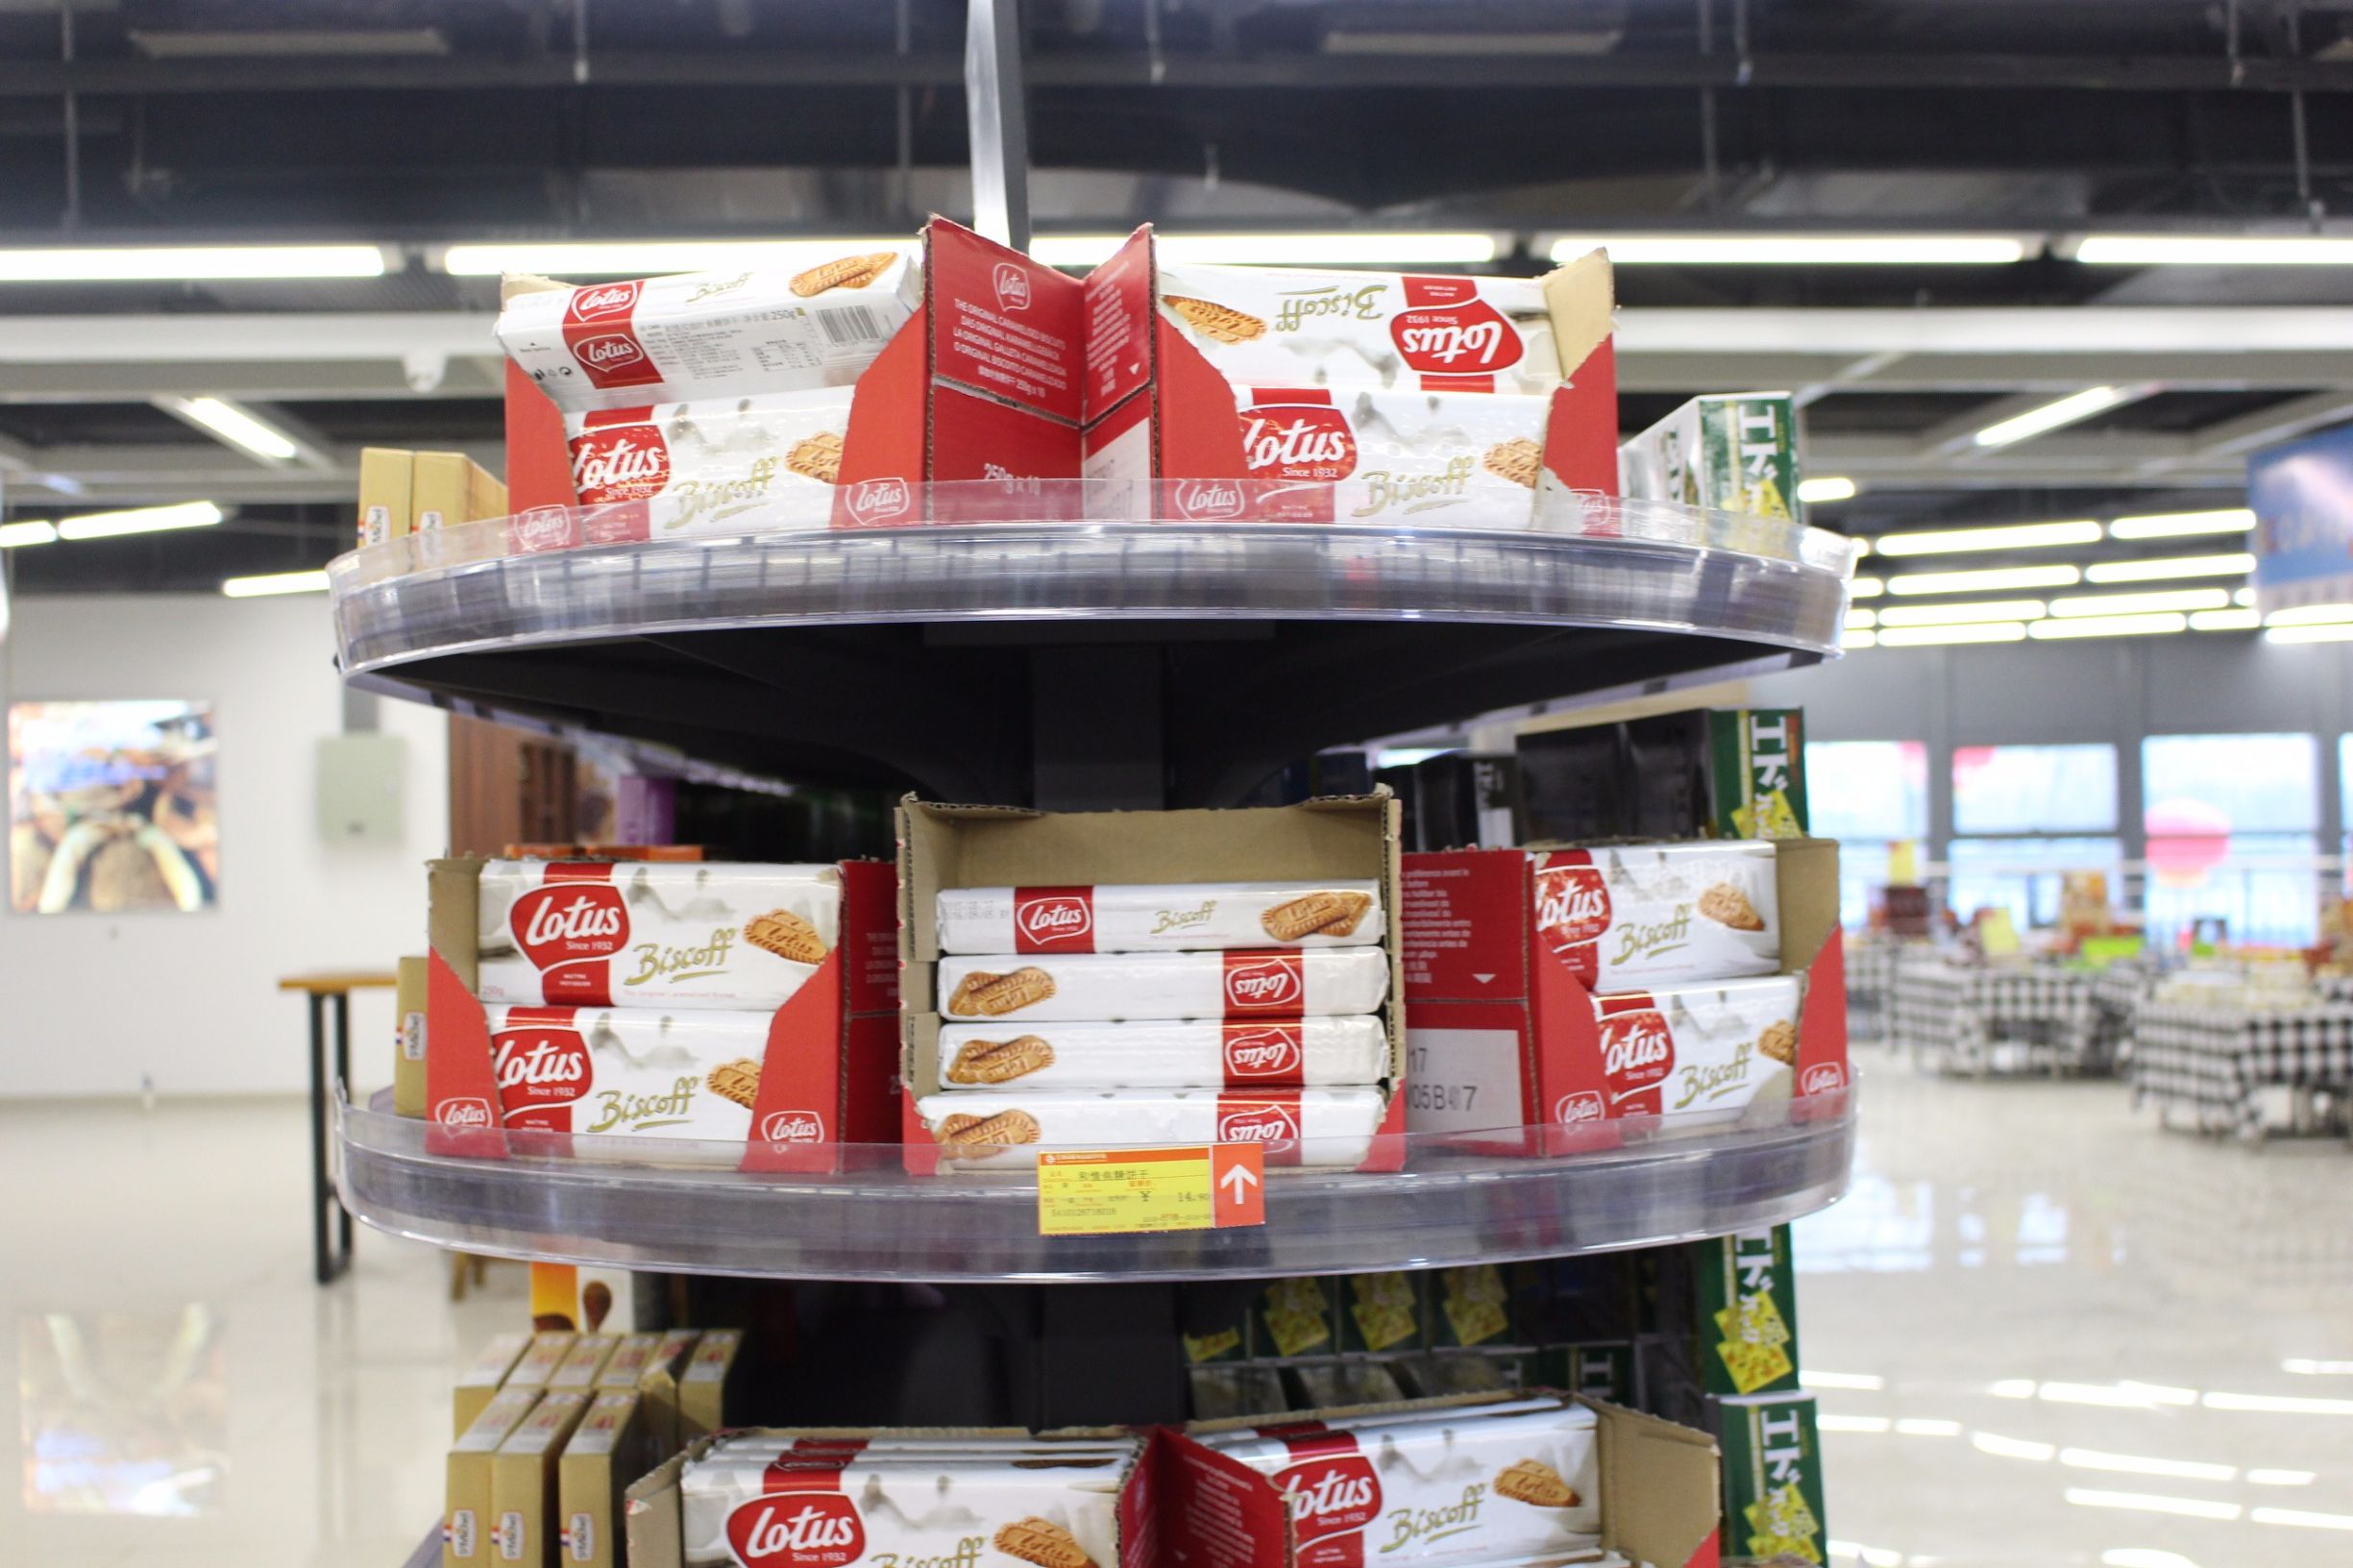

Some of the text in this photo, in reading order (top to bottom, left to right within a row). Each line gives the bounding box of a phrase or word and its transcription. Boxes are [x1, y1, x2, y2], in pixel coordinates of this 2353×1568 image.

[579, 288, 631, 310] Lotus
[1275, 284, 1388, 331] Biscoff
[1406, 315, 1458, 325] Since 1932
[588, 341, 635, 363] Lotus
[1403, 320, 1503, 364] Lotus
[1242, 418, 1345, 470] Lotus
[573, 438, 663, 494] Lotus
[1282, 467, 1337, 478] Since 1932
[664, 455, 779, 529] Biscoff
[857, 483, 902, 511] Lotus
[1188, 485, 1237, 510] Lotus
[1351, 455, 1476, 516] Biscoff
[526, 895, 621, 945] Lotus
[1029, 904, 1082, 930] Lotus
[1149, 900, 1217, 935] Biscoff
[1535, 878, 1605, 932] Lotus
[565, 942, 613, 951] Since 1932
[1610, 903, 1692, 966] Biscoff
[623, 928, 738, 986] Biscoff
[1236, 972, 1288, 998] Lotus
[495, 1040, 583, 1089] Lotus
[1235, 1041, 1287, 1068] Lotus
[527, 1087, 551, 1095] Since
[1674, 1041, 1753, 1110] Biscoff
[446, 1103, 486, 1124] Lotus
[586, 1076, 702, 1133] Biscoff
[772, 1116, 817, 1140] Lotus
[1230, 1120, 1286, 1141] Lotus
[1285, 1469, 1372, 1522] Lotus
[746, 1506, 854, 1558] Lotus
[1317, 1517, 1341, 1526] Since
[1379, 1482, 1487, 1553] Biscoff
[792, 1552, 846, 1561] Since 1932
